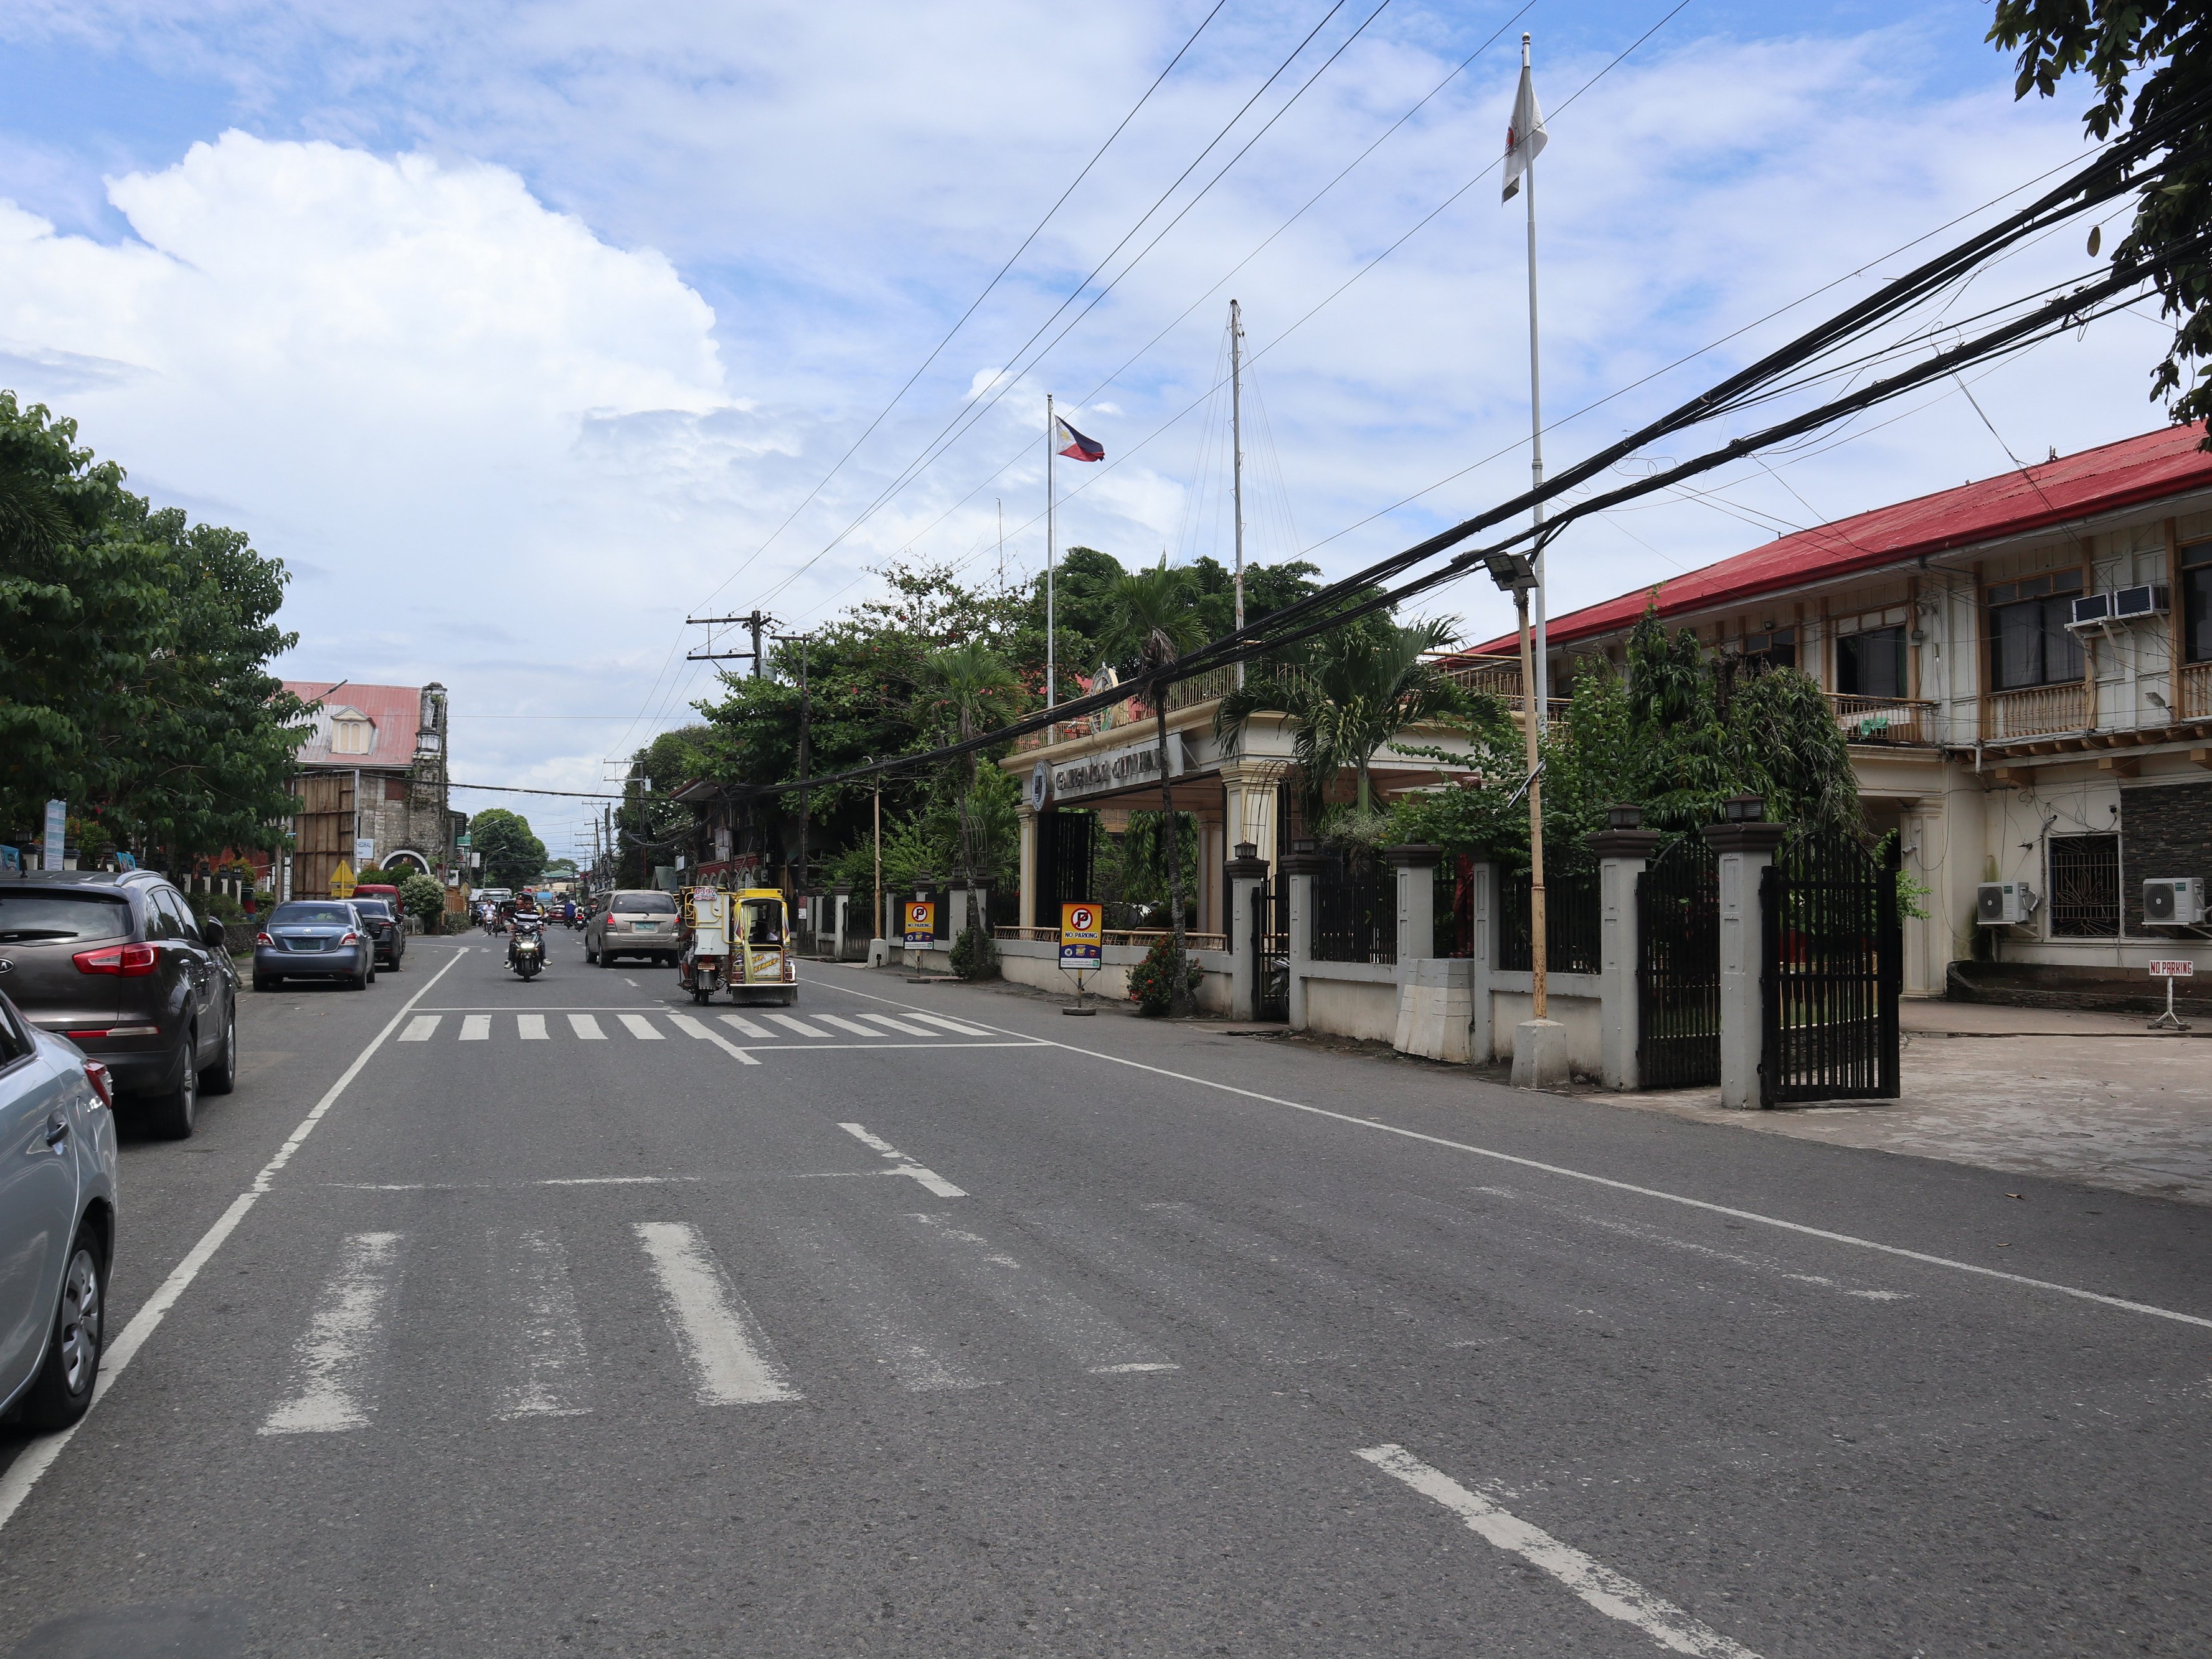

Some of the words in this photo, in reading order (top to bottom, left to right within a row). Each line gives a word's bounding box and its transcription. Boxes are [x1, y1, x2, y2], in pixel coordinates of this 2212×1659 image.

[1137, 749, 1161, 773] HAL
[753, 957, 778, 973] STANCE
[2150, 962, 2160, 974] NO
[2162, 962, 2192, 975] PARKING
